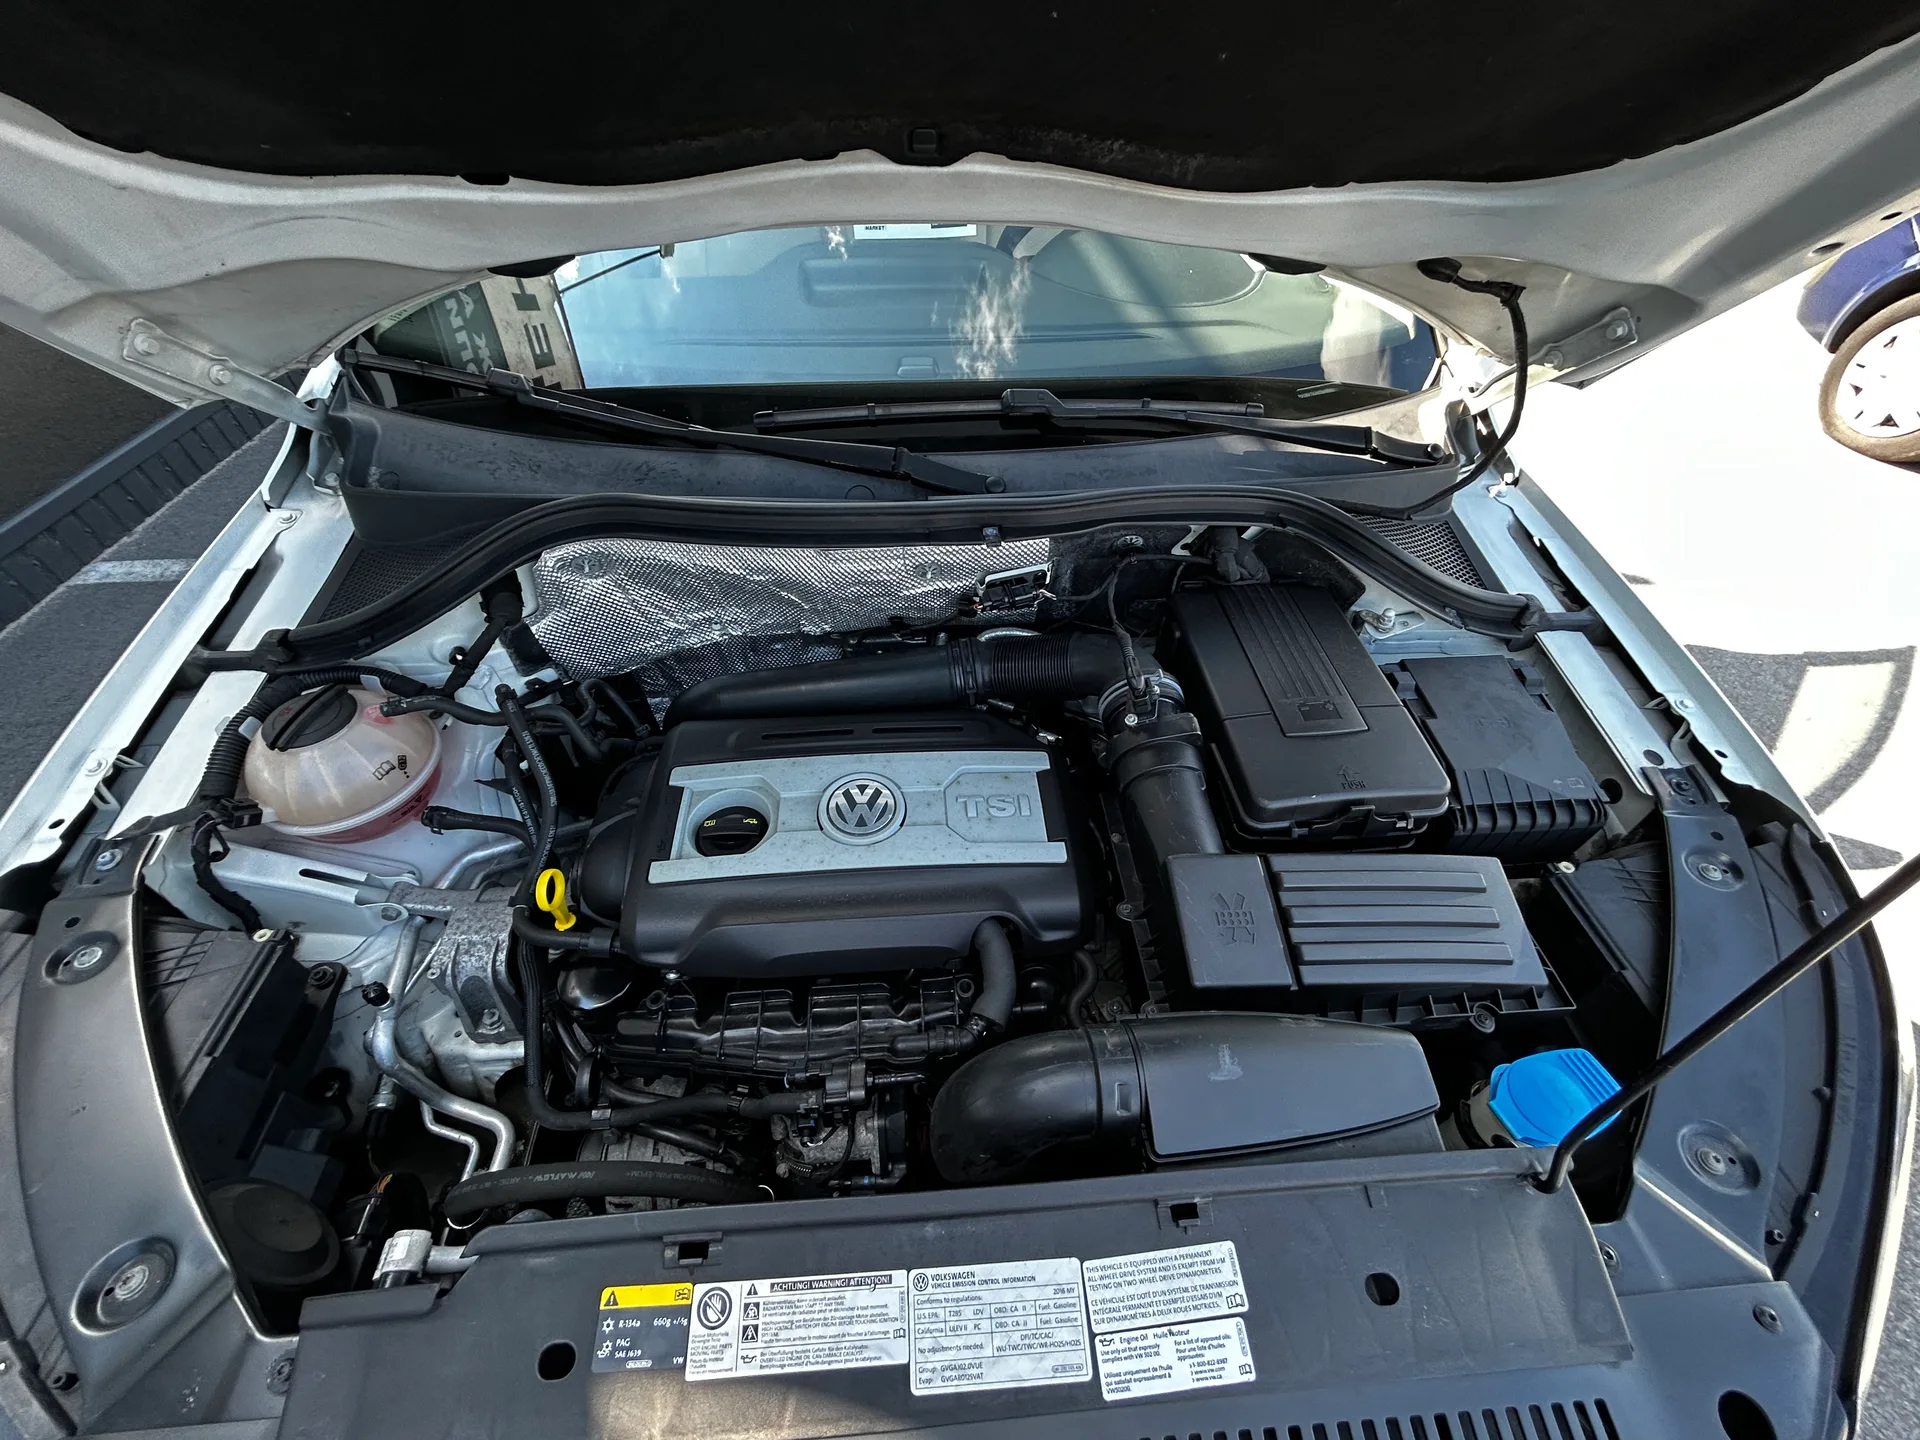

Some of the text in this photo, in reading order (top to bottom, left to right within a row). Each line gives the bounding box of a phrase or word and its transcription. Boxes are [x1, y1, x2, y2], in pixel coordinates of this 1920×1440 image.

[1341, 780, 1366, 790] PUSH
[955, 792, 1031, 820] TSI
[1098, 1263, 1122, 1271] VEHICLE
[1129, 1258, 1157, 1268] EQUIPPED
[1178, 1250, 1212, 1260] PERMANENT
[1136, 1267, 1157, 1275] SYSTEM
[1177, 1261, 1198, 1269] EXEMPT
[930, 1271, 975, 1281] VOLKSWAGEN
[1001, 1275, 1036, 1283] INFORMATION
[772, 1276, 889, 1291] ACHTUNG! WARNING! ATTENTION!
[1088, 1282, 1112, 1291] TESTING
[1198, 1279, 1238, 1290] TRANSMISSION
[1121, 1300, 1154, 1311] PERMANENT
[1173, 1304, 1191, 1313] ROUES
[618, 1319, 640, 1327] R-134a
[1119, 1335, 1139, 1345] Engine
[1199, 1334, 1222, 1343] approved
[927, 1344, 961, 1354] adjustments
[1138, 1343, 1160, 1351] expressly
[1101, 1355, 1123, 1364] complies
